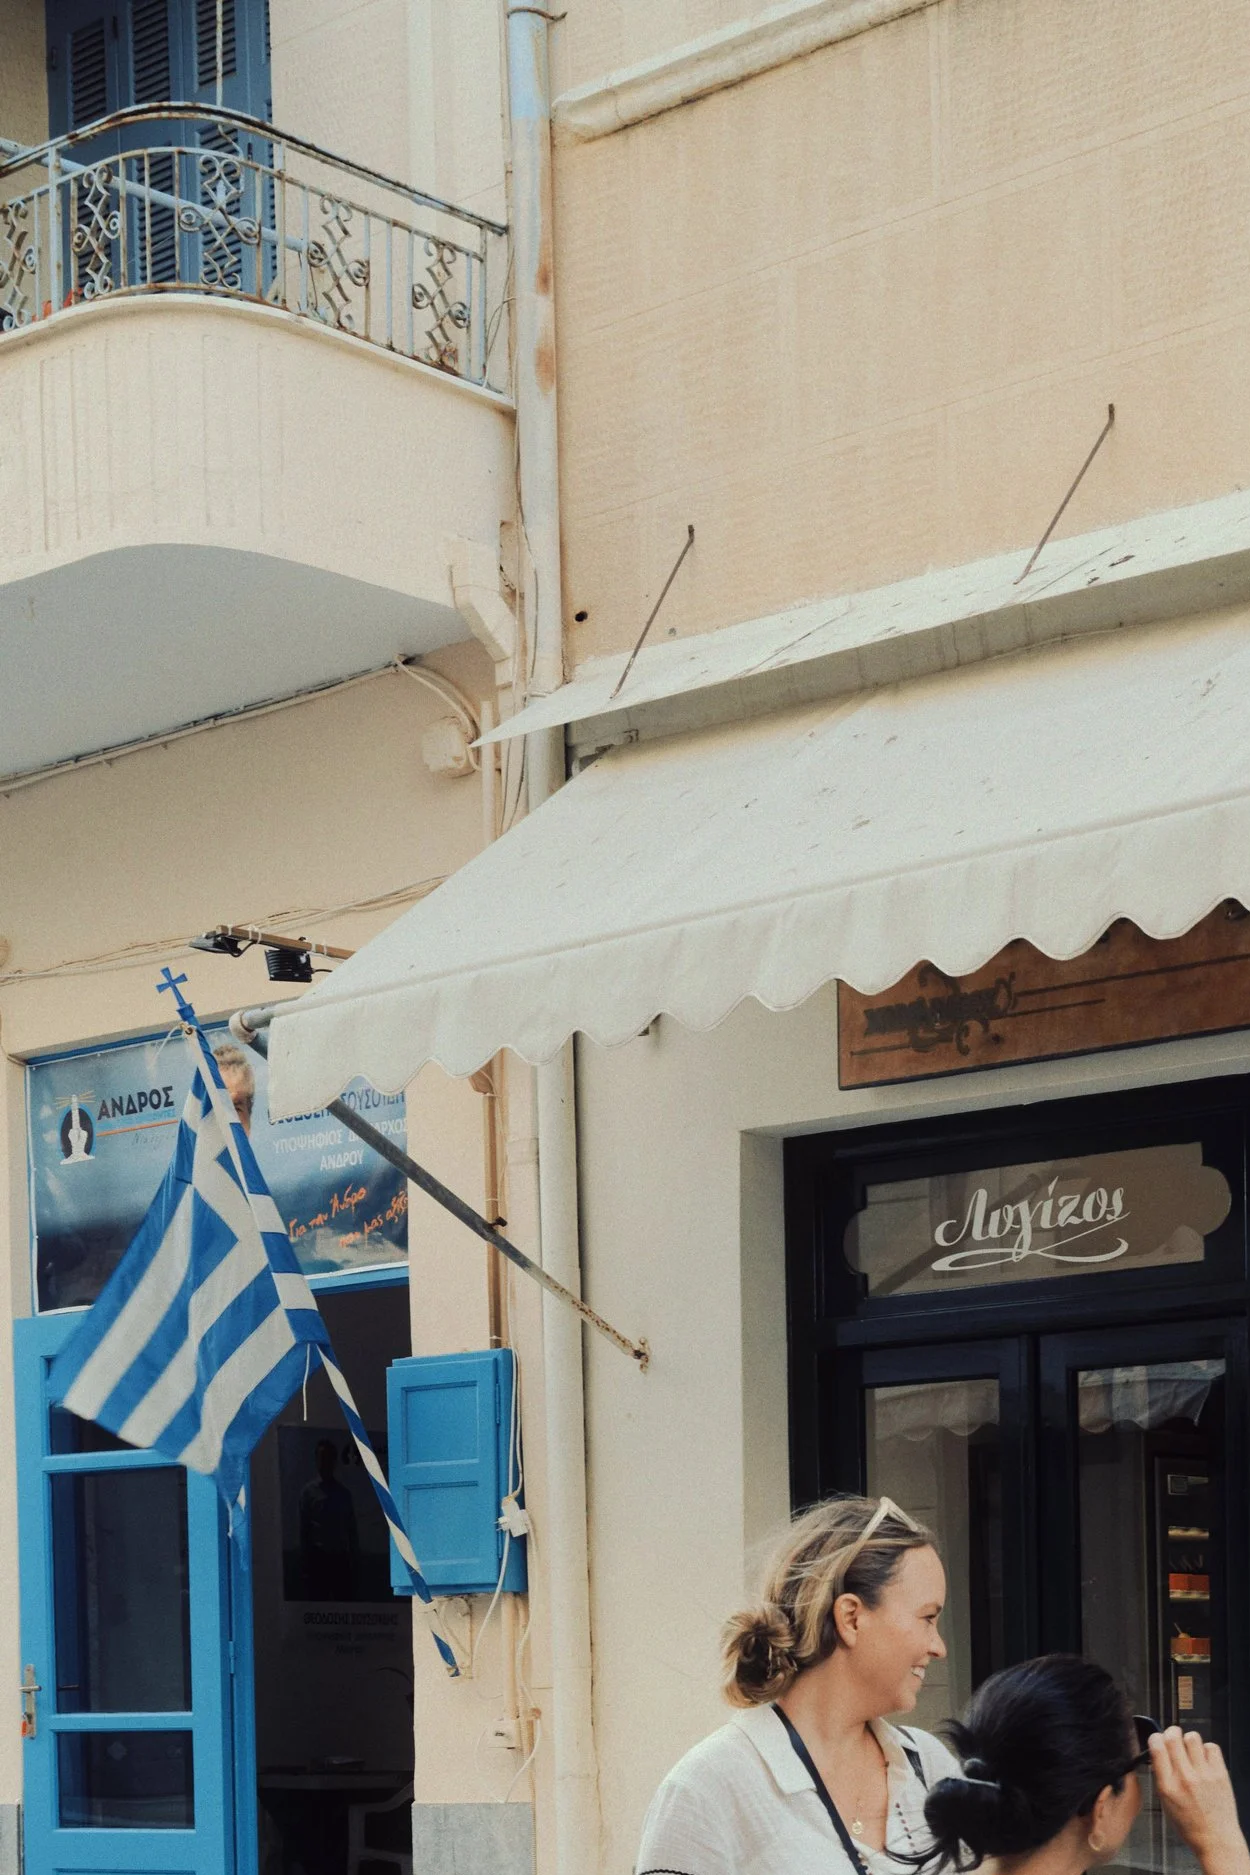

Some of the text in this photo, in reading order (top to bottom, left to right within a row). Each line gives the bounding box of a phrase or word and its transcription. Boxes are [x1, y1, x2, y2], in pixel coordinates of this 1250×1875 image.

[97, 1085, 175, 1121] ΑΝΔΡΟΣ
[273, 1128, 343, 1155] ΥΠΟΨΗΦΙΟΣ
[319, 1149, 365, 1171] ΑΝΔΡΟΥ
